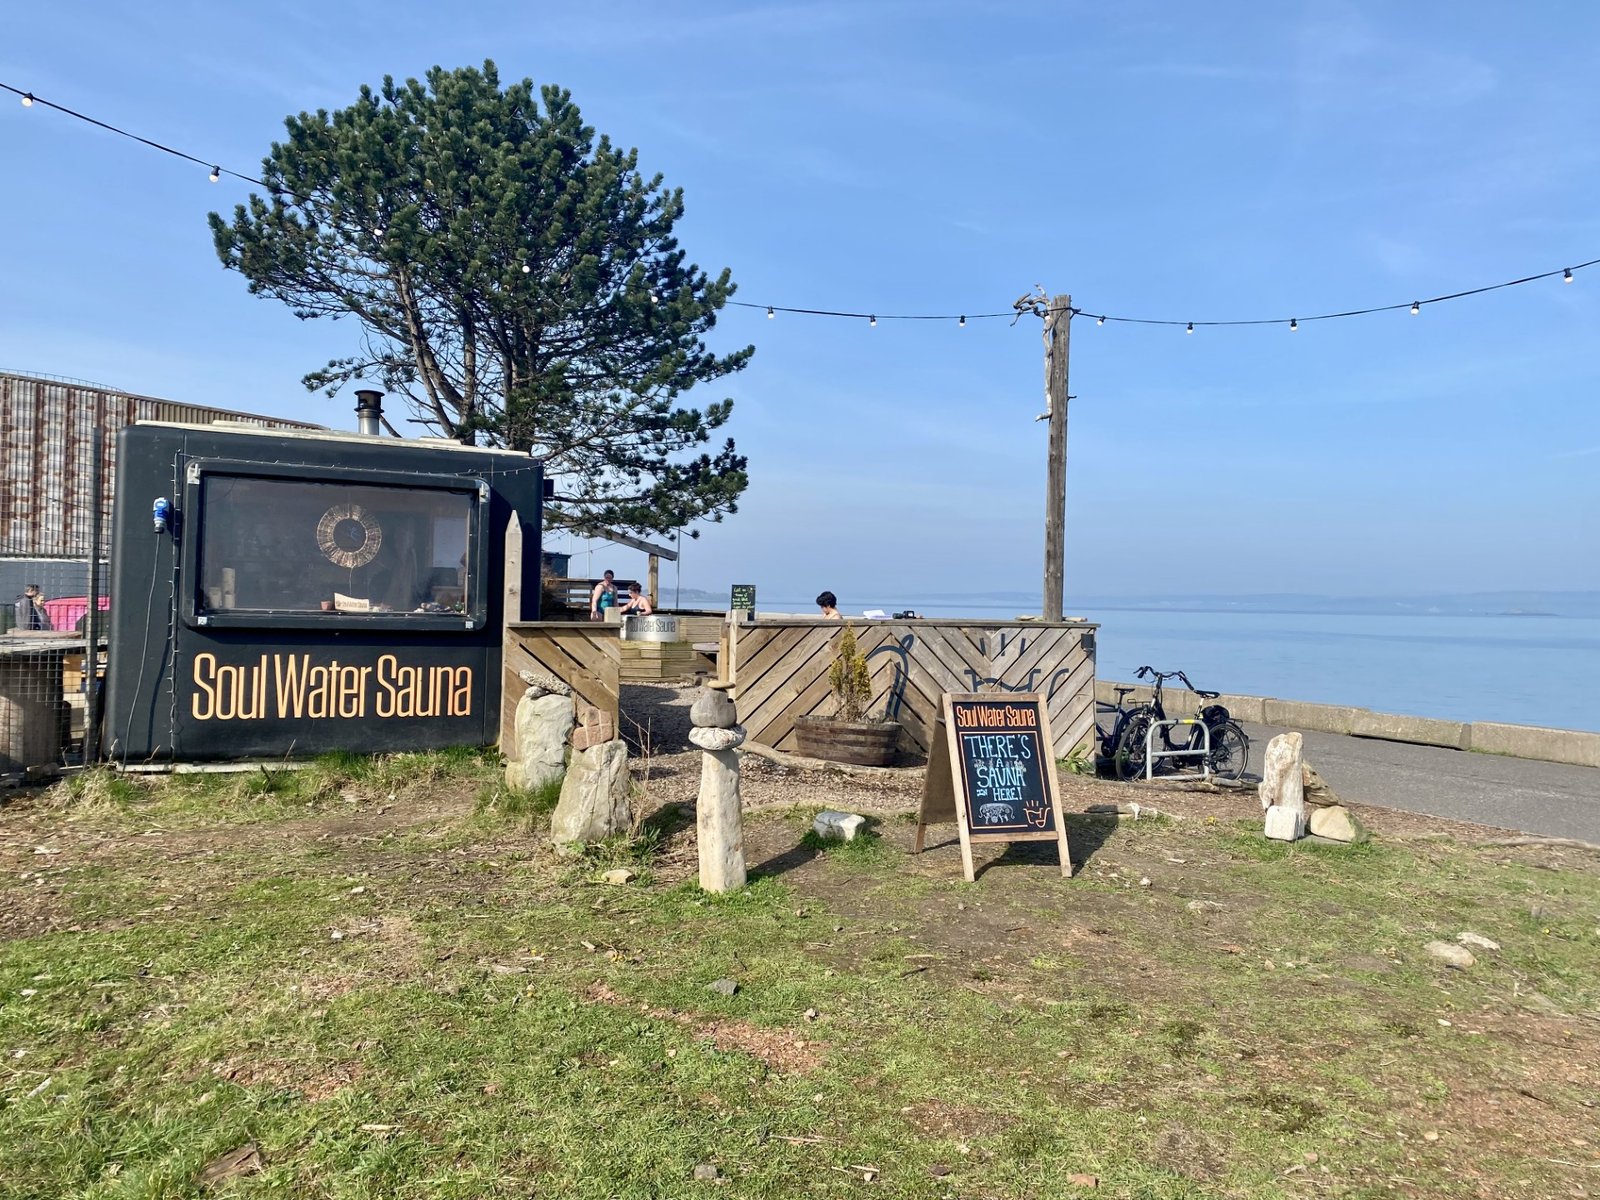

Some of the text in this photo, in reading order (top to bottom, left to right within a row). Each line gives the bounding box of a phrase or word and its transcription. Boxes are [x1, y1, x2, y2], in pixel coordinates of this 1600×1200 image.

[655, 618, 676, 633] Sauna
[192, 653, 473, 720] Soul Water Sauna
[957, 705, 1036, 727] Soul Water Sauna
[964, 735, 1031, 759] THERE'S
[996, 758, 1003, 767] A
[977, 767, 1026, 787] SAUNA
[993, 787, 1023, 800] HERE!
